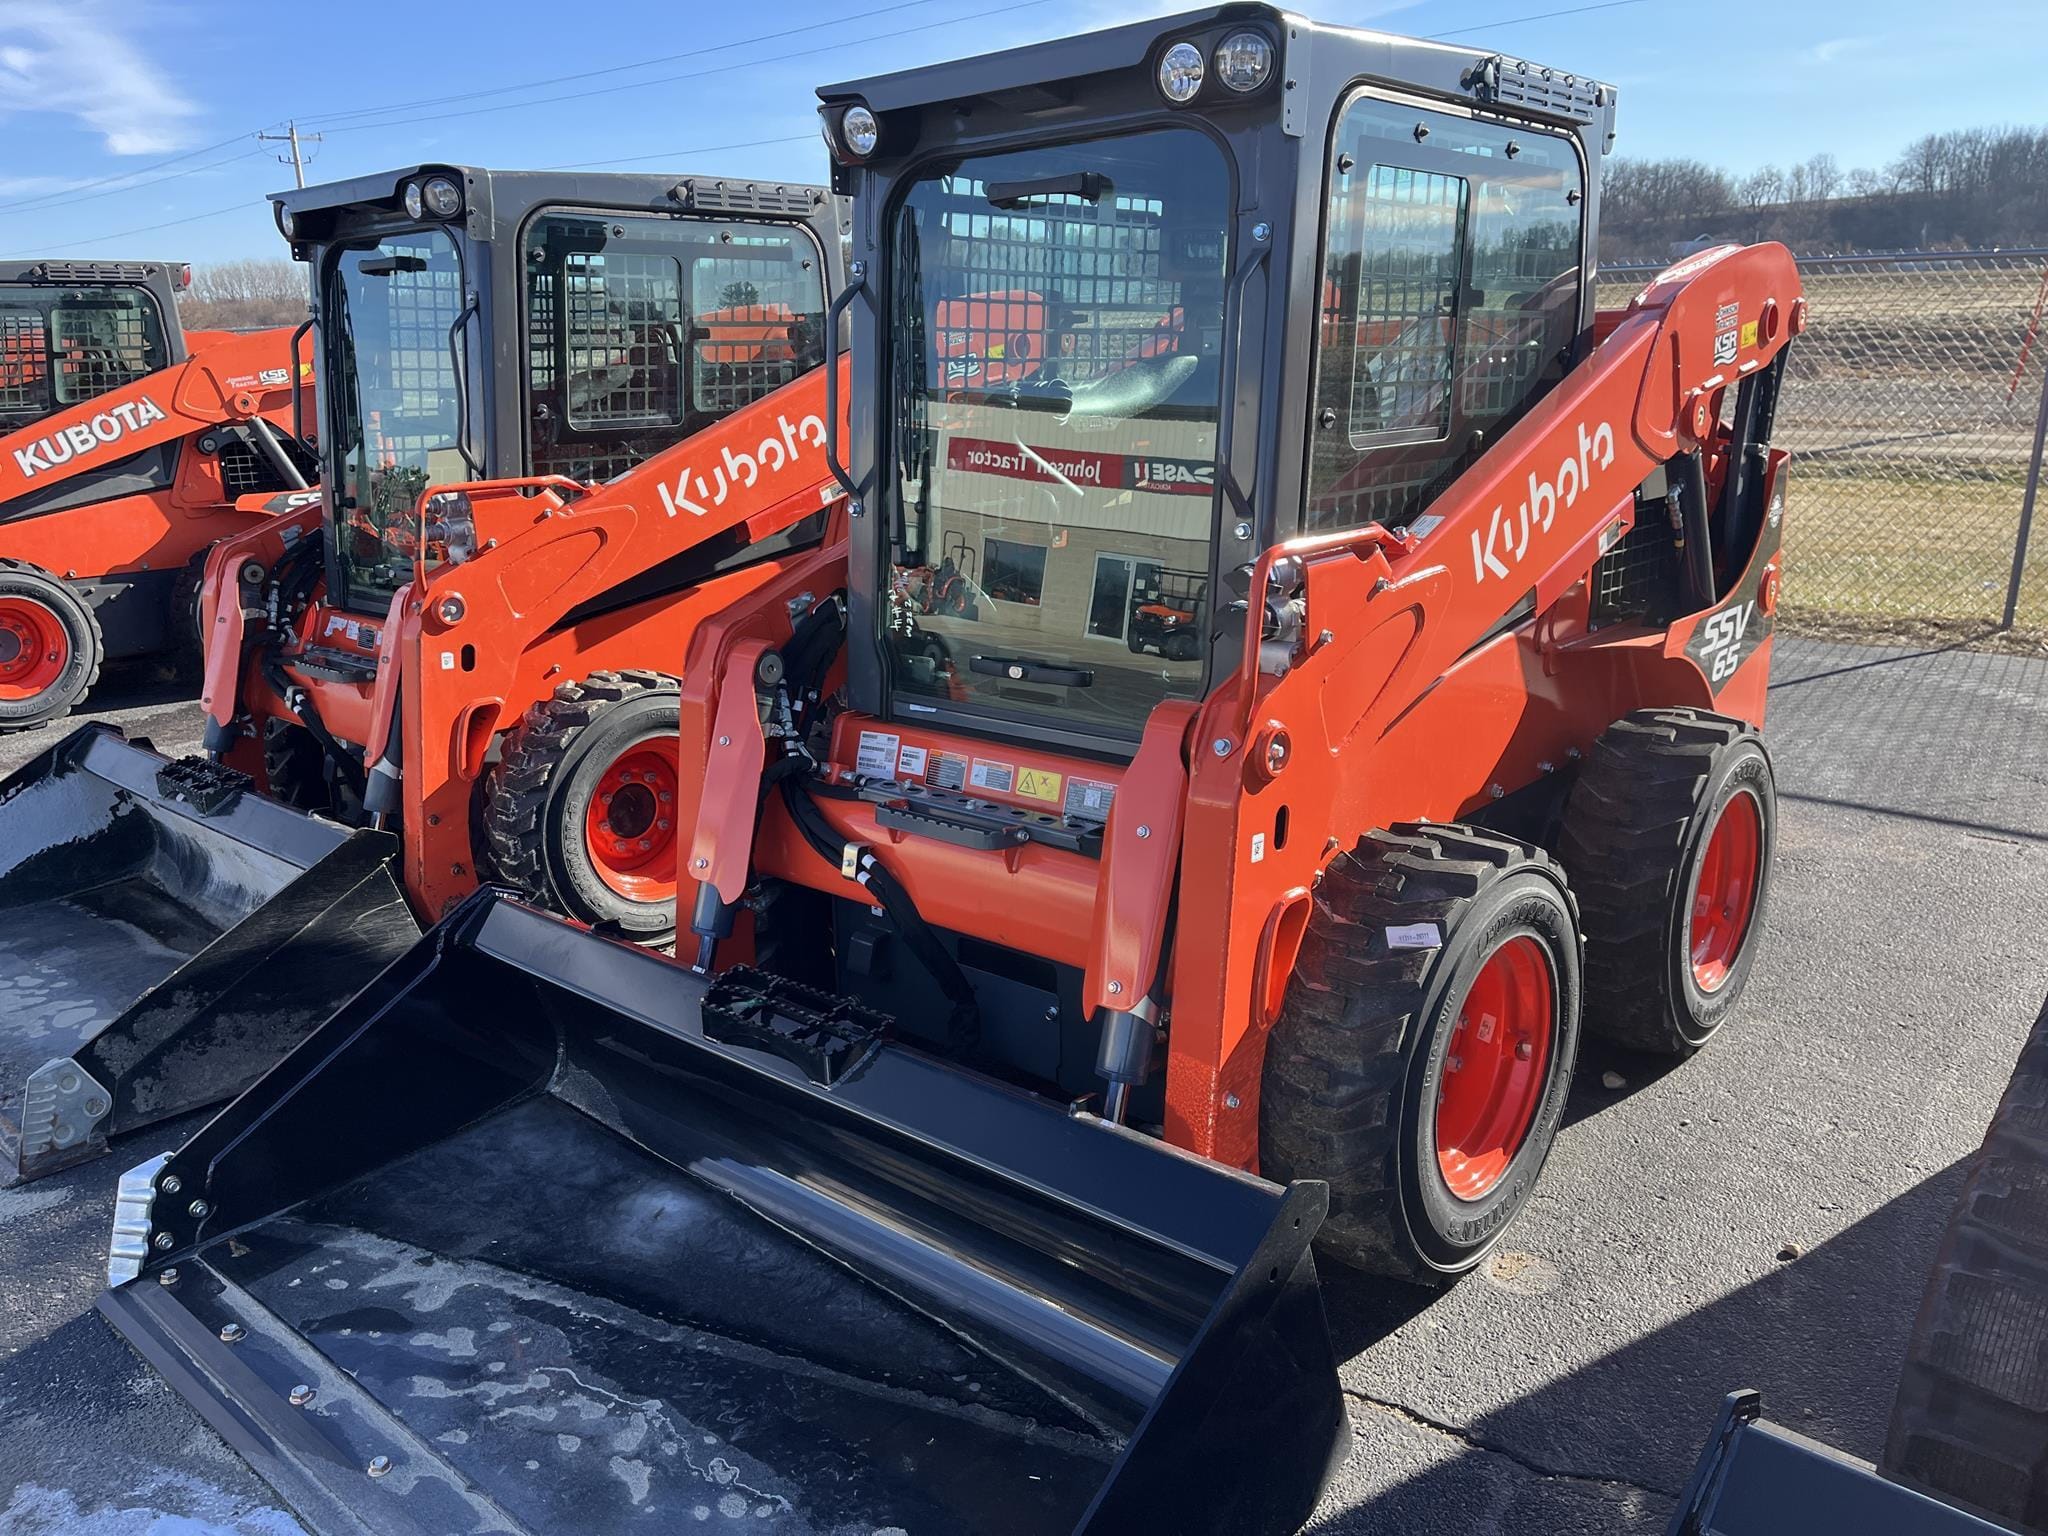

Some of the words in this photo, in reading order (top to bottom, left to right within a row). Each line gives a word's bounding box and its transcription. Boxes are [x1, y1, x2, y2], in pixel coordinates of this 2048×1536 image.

[1714, 330, 1737, 355] KSR
[259, 369, 288, 382] KSR
[13, 396, 166, 477] KUBOTA
[656, 415, 827, 518] Kubota
[1471, 422, 1615, 584] Kubota
[1699, 600, 1755, 658] SSV
[1711, 642, 1741, 683] 65
